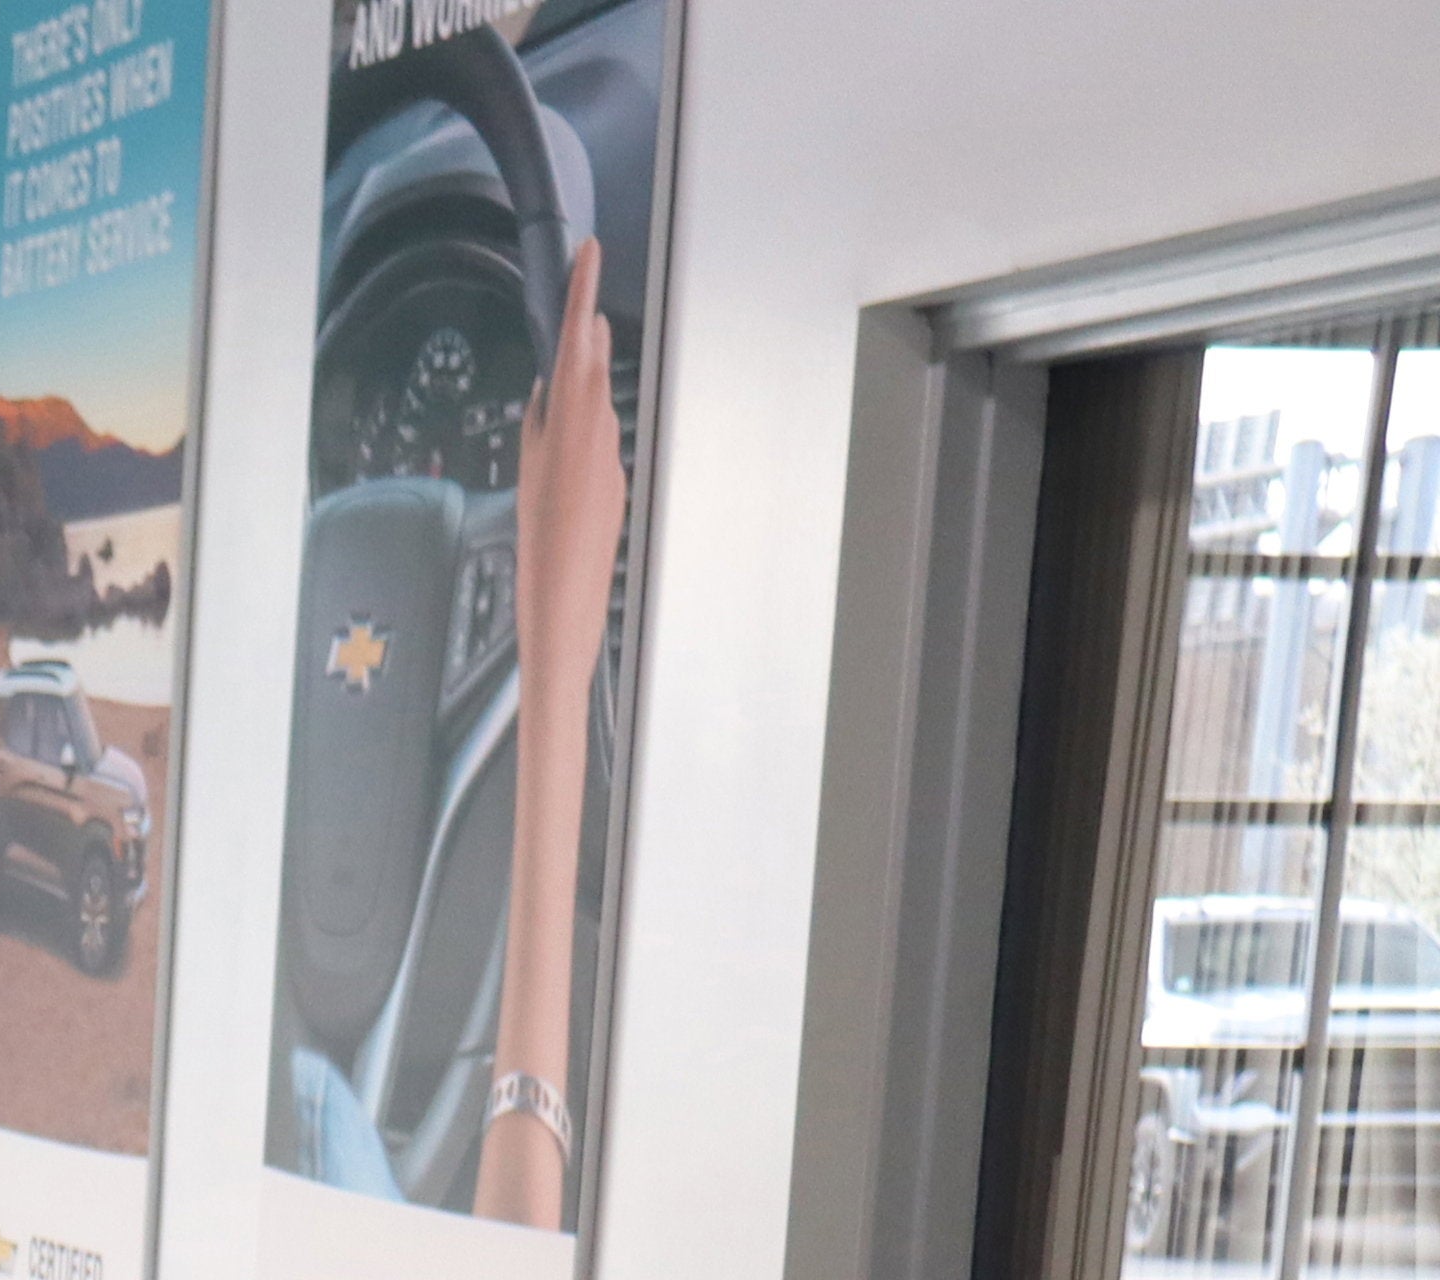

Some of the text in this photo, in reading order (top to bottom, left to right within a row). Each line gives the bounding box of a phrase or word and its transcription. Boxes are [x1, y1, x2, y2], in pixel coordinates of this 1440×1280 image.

[12, 0, 143, 85] THERE'S ONLY
[349, 0, 405, 70] AND
[7, 39, 174, 157] POSITIVES WHEN
[4, 136, 122, 228] IT COMES TO
[1, 190, 175, 297] BATTERY SERVICE
